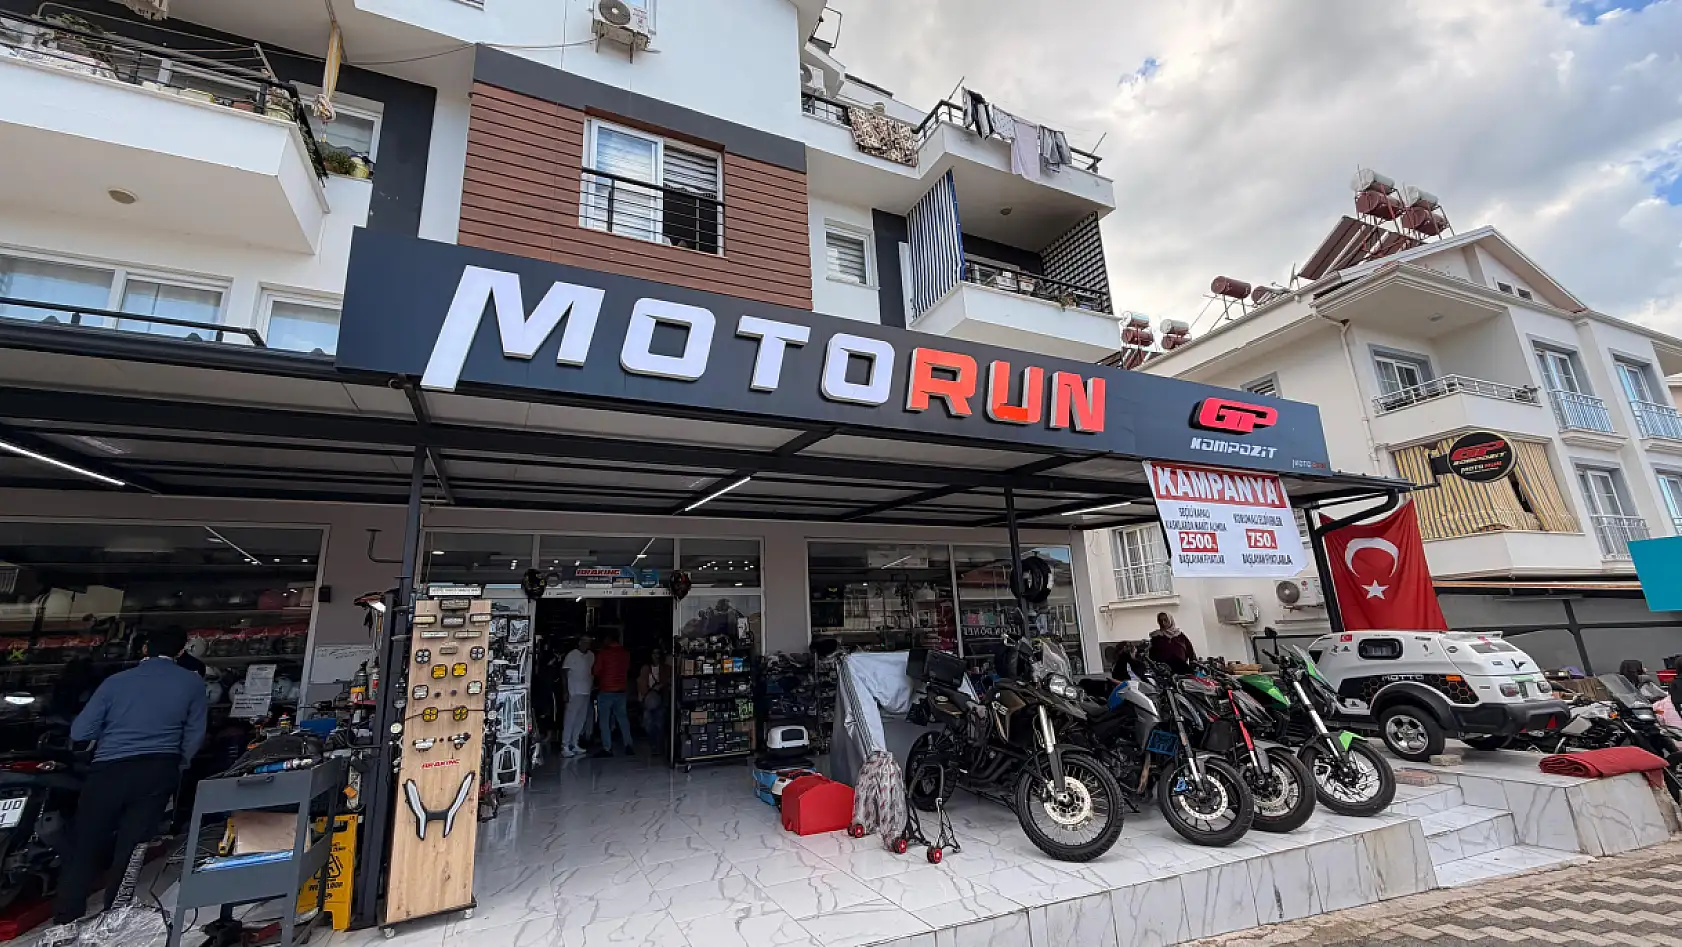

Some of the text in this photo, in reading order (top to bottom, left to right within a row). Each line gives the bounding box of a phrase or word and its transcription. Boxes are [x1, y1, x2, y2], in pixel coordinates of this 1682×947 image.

[421, 265, 1106, 433] MOTORUN
[1197, 397, 1279, 433] GP
[1157, 466, 1279, 504] KAMPANYA
